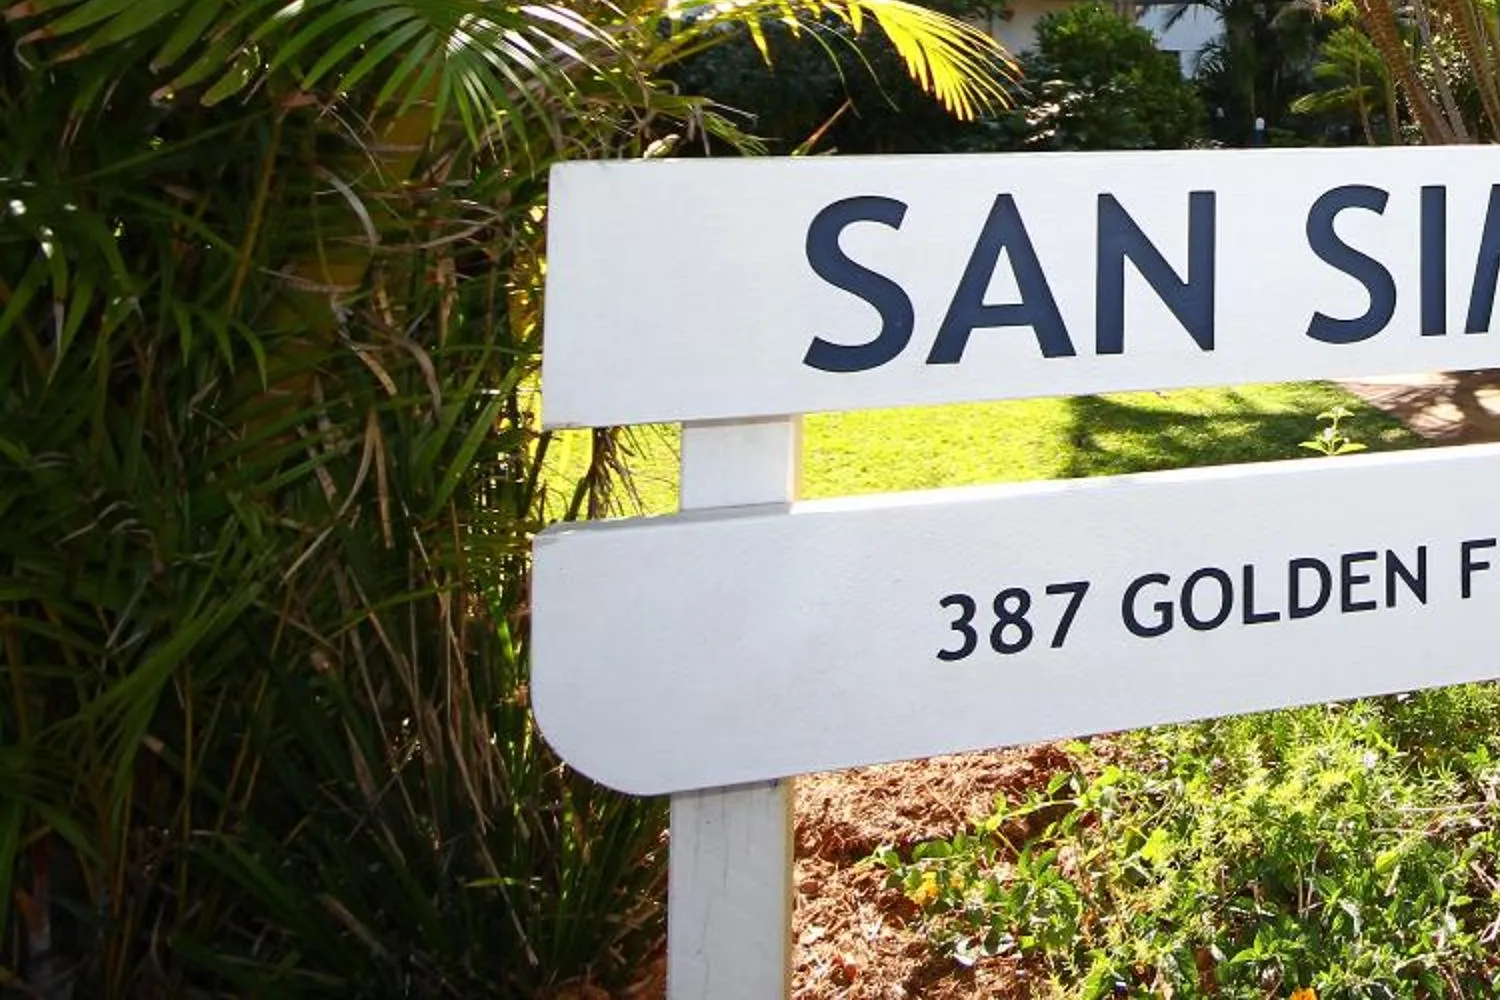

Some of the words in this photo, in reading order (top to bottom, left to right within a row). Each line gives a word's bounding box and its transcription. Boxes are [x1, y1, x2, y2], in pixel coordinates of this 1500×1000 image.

[803, 191, 1217, 373] SAN
[937, 582, 1090, 661] 387
[1122, 546, 1428, 638] GOLDEN
